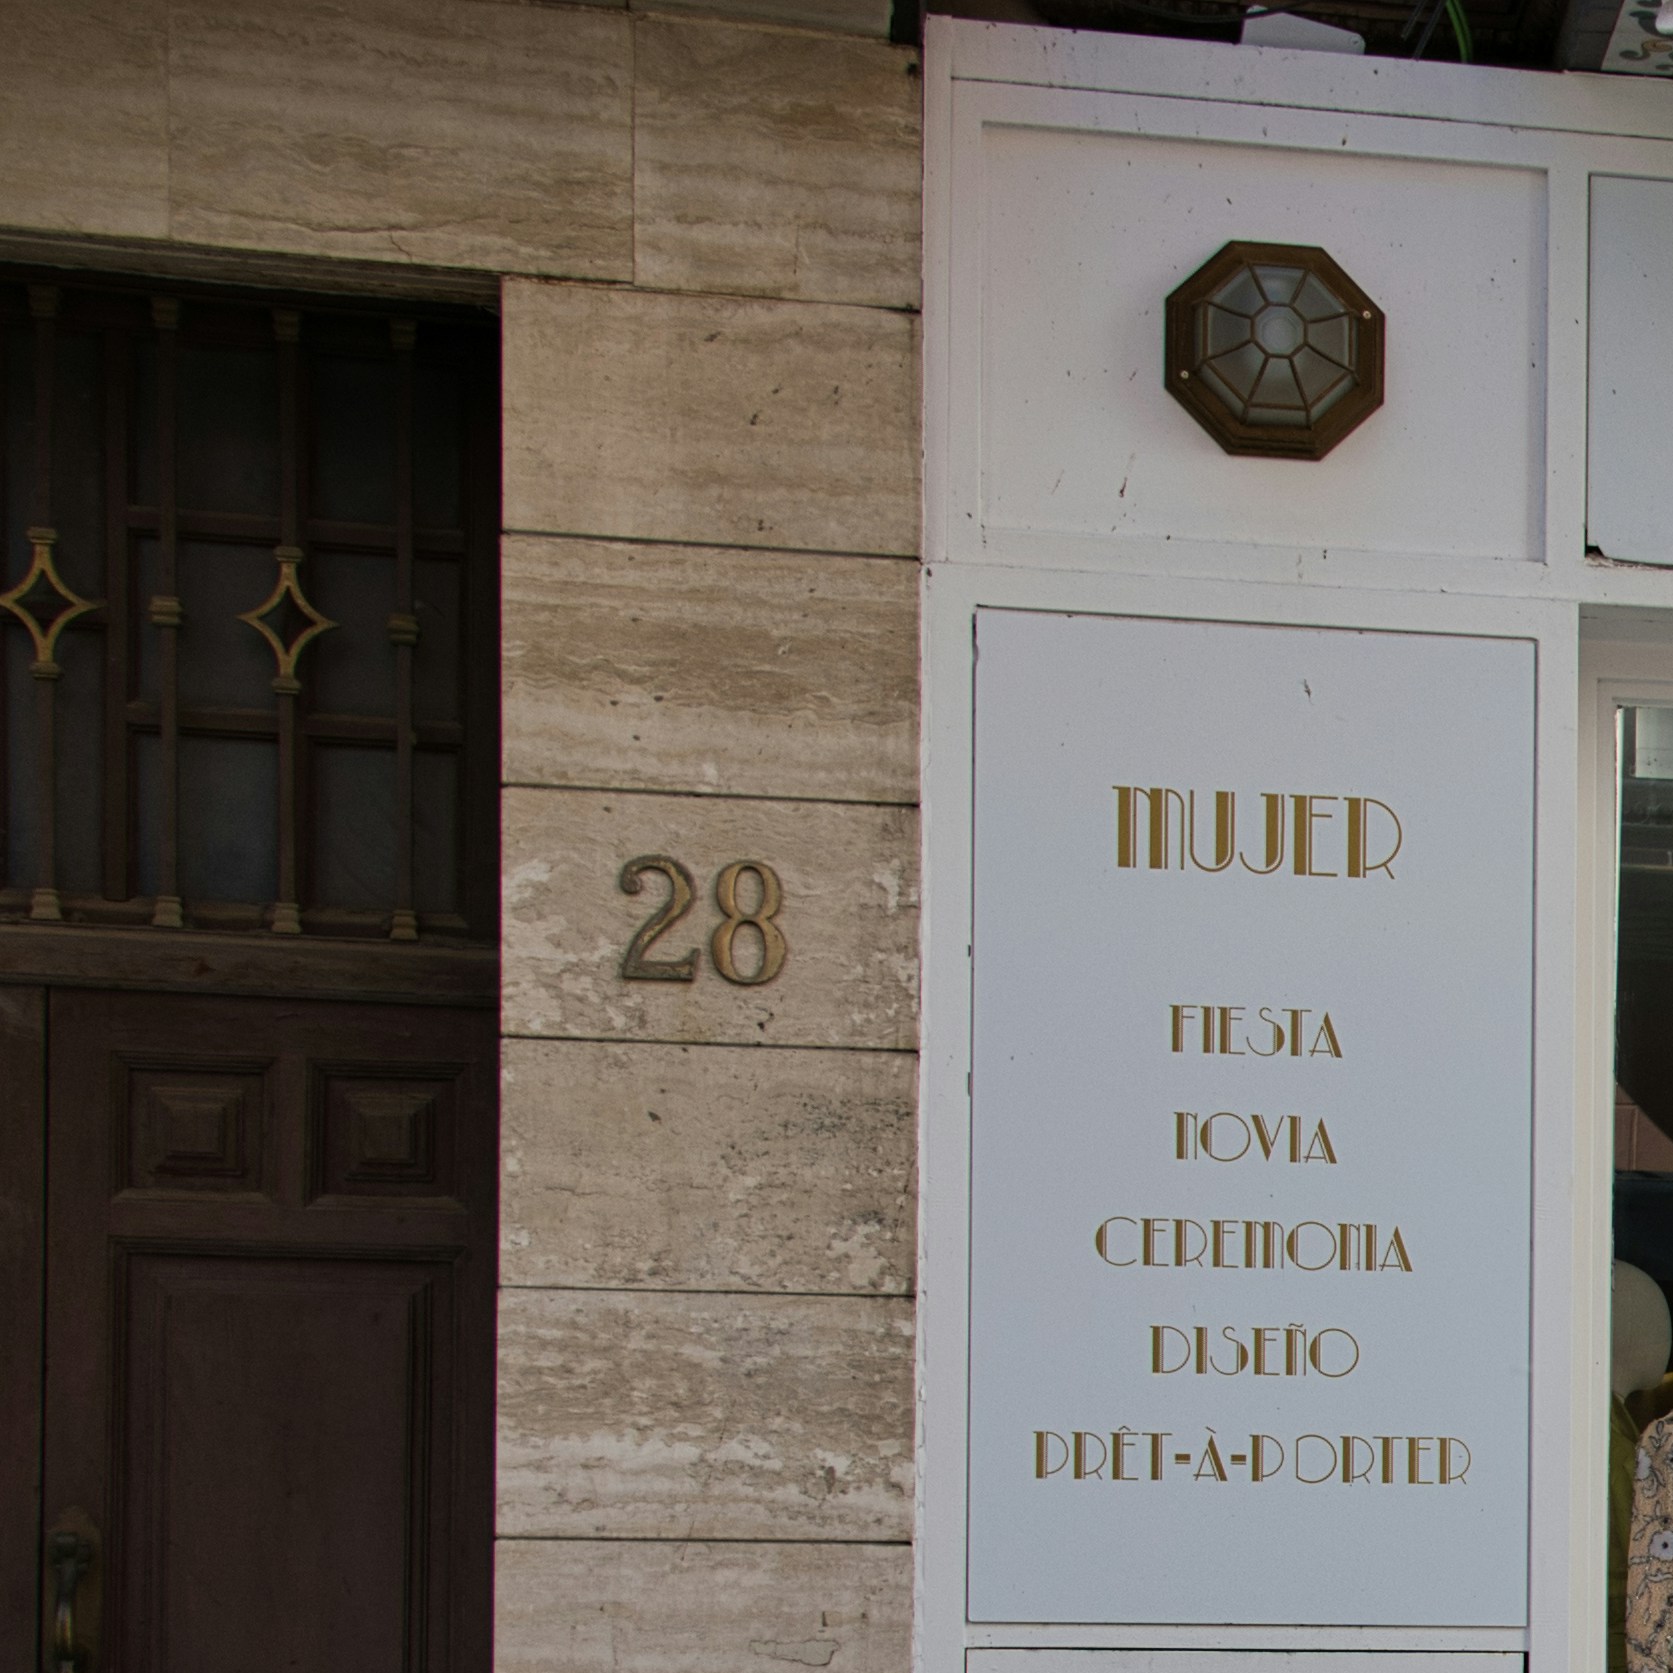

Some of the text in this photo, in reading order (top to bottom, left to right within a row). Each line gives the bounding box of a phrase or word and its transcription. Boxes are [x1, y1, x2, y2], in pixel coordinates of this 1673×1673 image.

[1112, 785, 1403, 879] MUJER
[619, 853, 787, 986] 28
[1169, 1004, 1343, 1059] FIESTA
[1174, 1111, 1338, 1165] NOVIA
[1094, 1216, 1413, 1273] CEREMONIA
[1149, 1322, 1360, 1378] DISEÑO
[1032, 1425, 1472, 1486] PRÊT-À-PORTER
